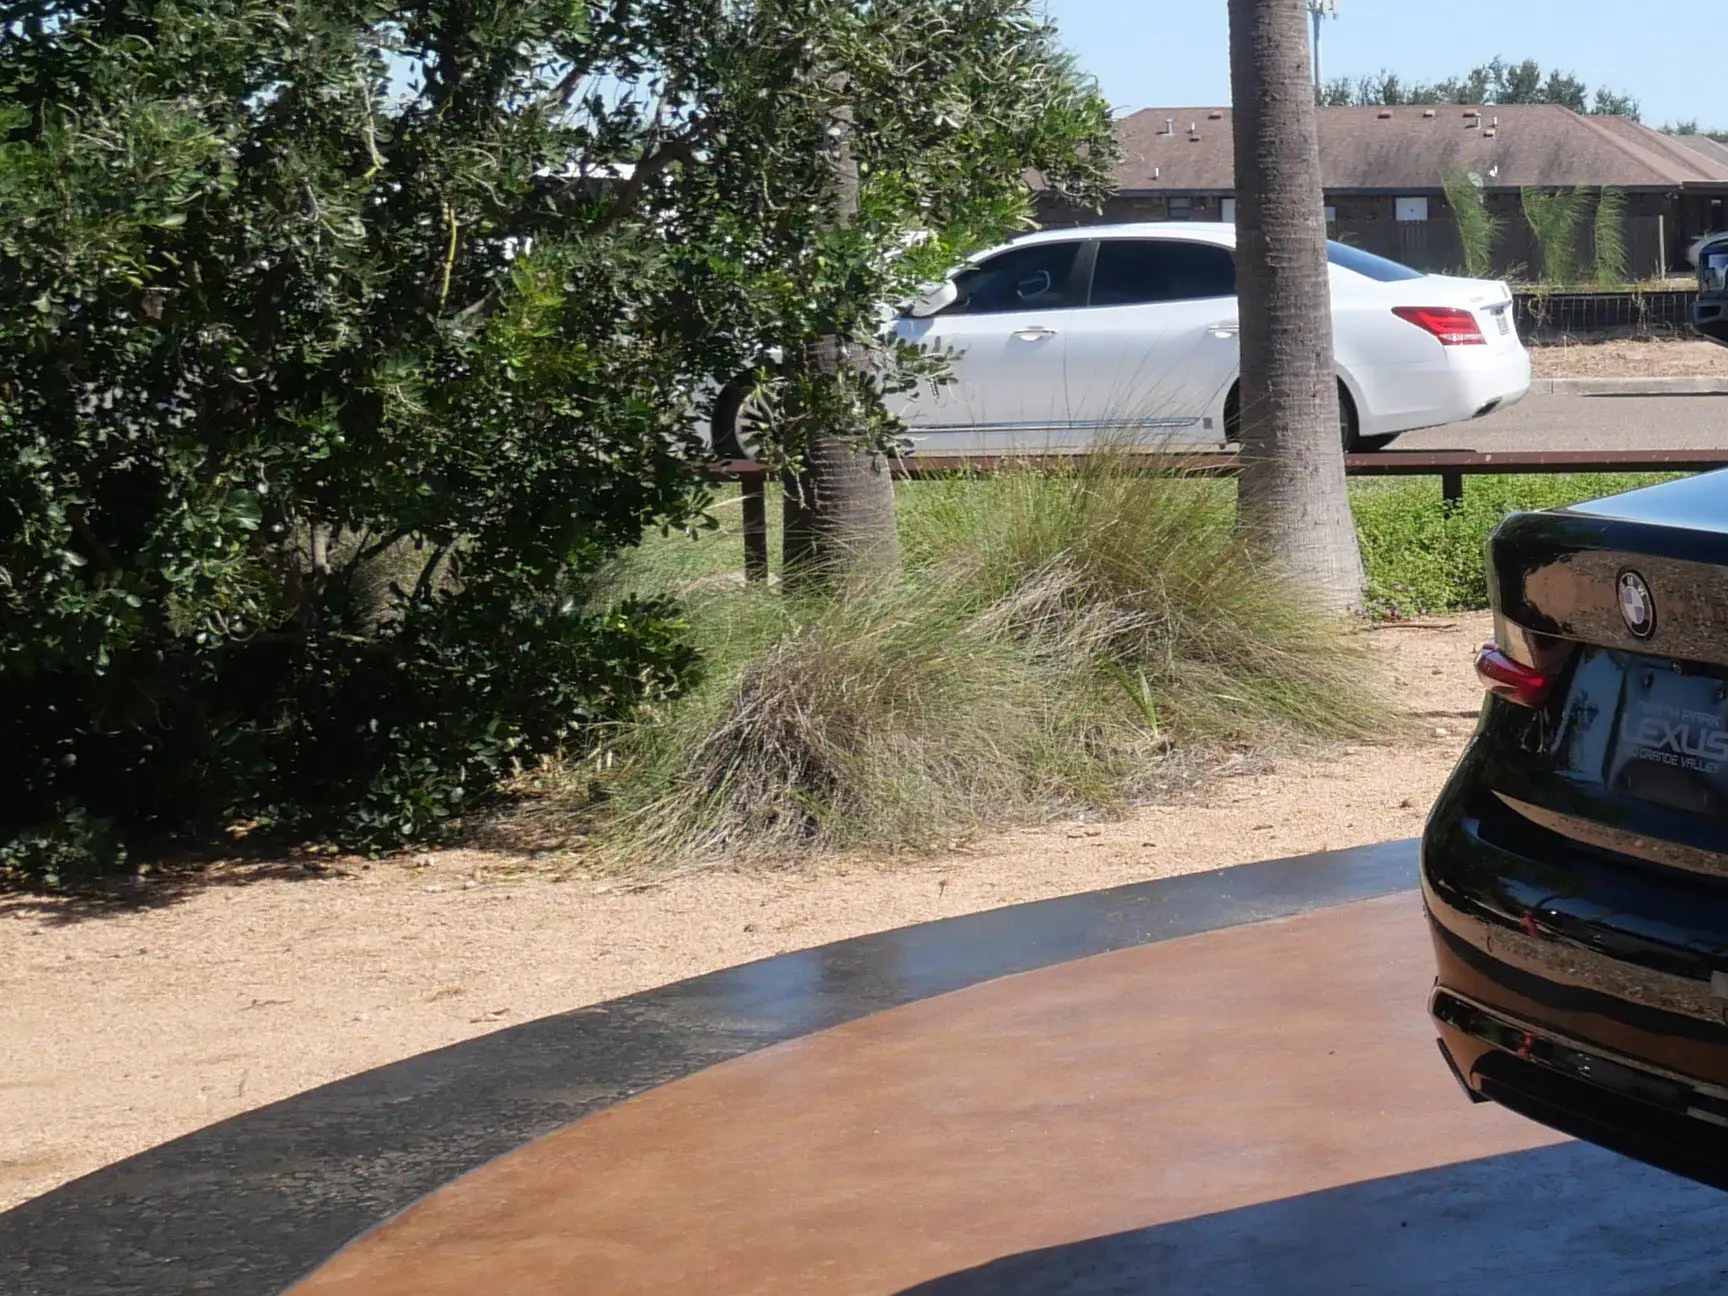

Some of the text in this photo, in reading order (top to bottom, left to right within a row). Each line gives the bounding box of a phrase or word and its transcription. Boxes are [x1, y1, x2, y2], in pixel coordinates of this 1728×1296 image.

[1636, 700, 1721, 728] NTH PARK
[1639, 748, 1680, 767] GRANDE
